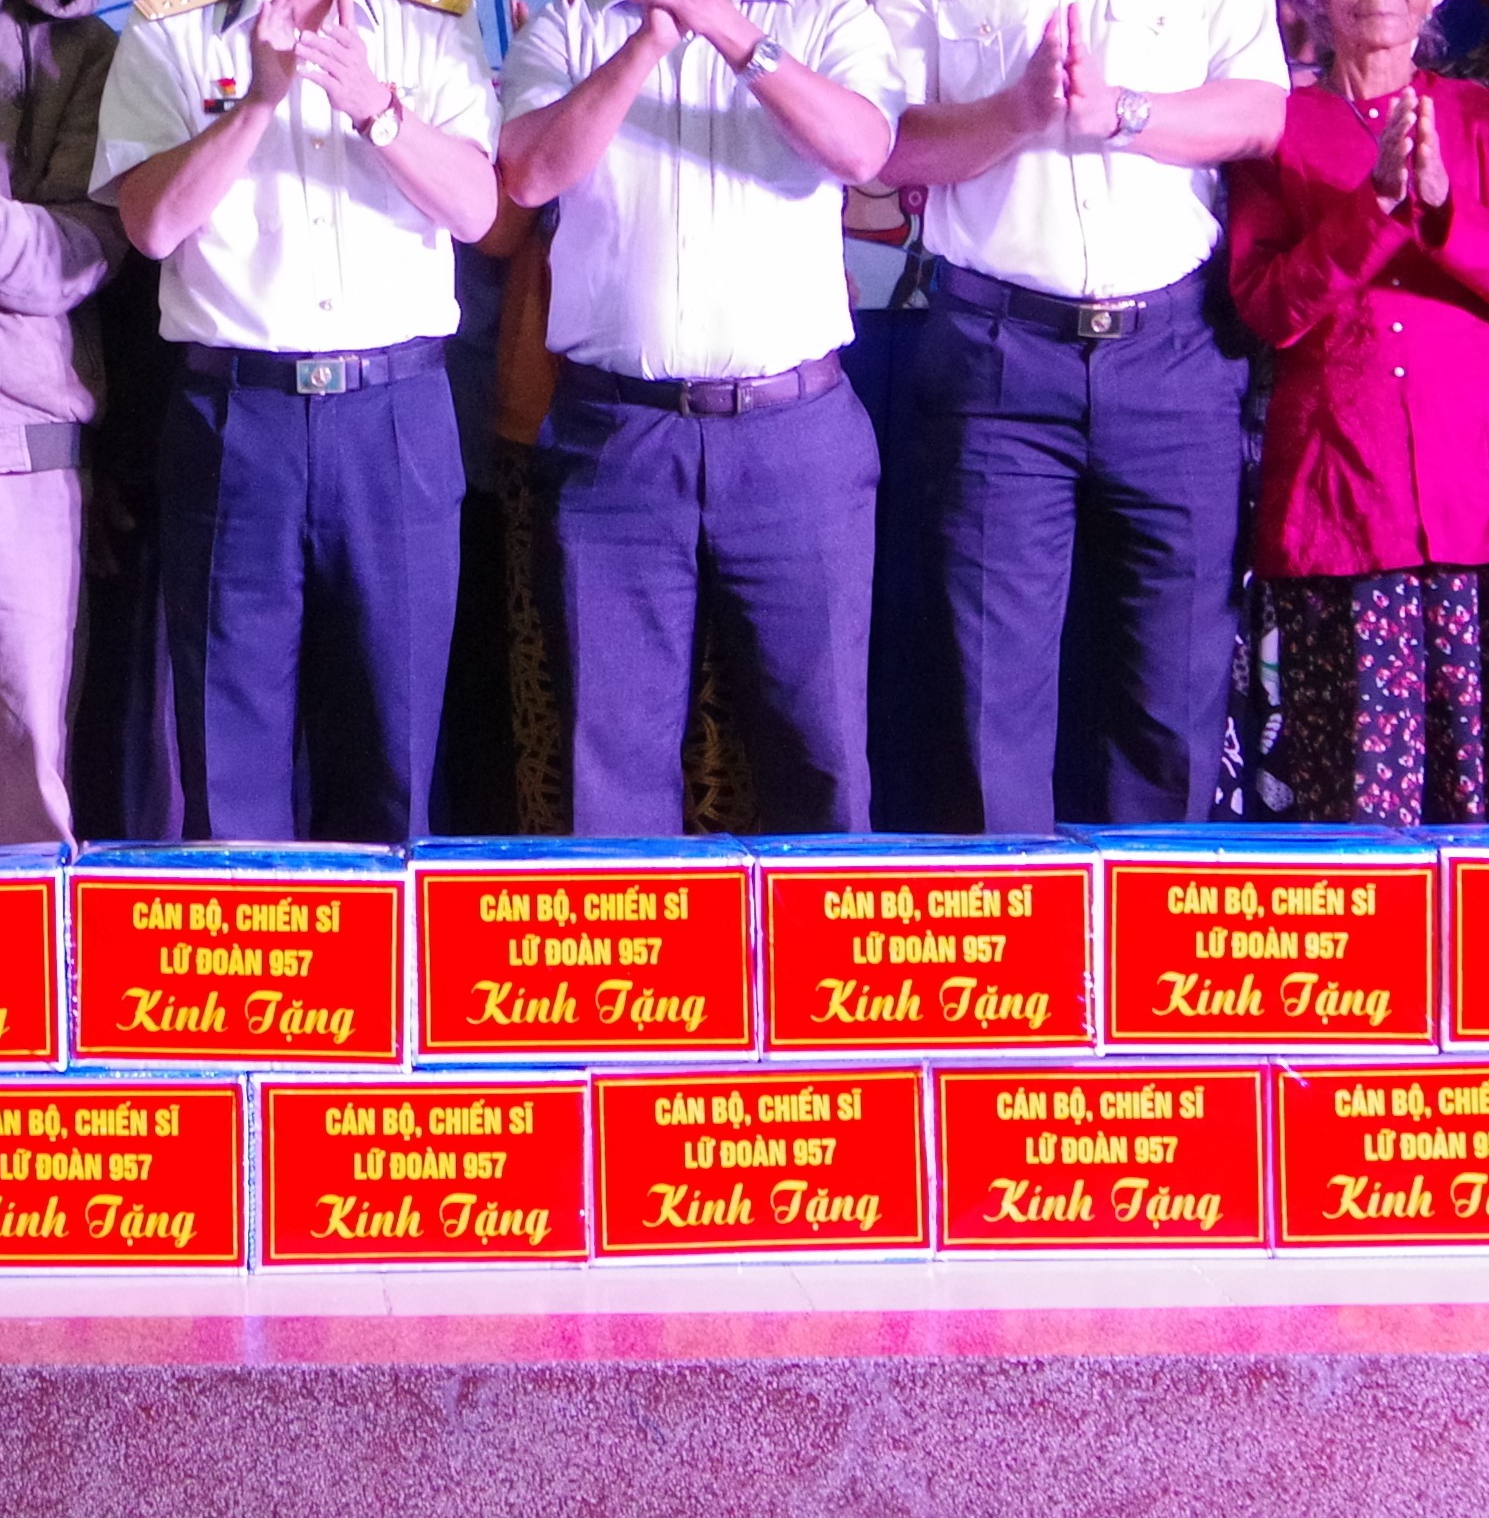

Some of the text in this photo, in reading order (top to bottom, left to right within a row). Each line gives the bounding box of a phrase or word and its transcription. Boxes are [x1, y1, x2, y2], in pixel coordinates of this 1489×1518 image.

[480, 885, 688, 926] CÁN BỘ, CHIẾN SĨ
[1168, 881, 1376, 920] CÁN BỘ, CHIẾN SĨ
[509, 933, 662, 966] LỮ ĐOÀN 957
[1196, 927, 1348, 959] LỮ ĐOÀN 957
[464, 979, 707, 1032] Kính Tặng
[1150, 972, 1393, 1026] Kính Tặng
[29, 1104, 67, 1141] BỘ,
[75, 1102, 147, 1136] CHIẾN
[155, 1105, 179, 1136] SĨ
[655, 1087, 861, 1129] CÁN BỘ, CHIẾN SĨ
[1335, 1085, 1385, 1117] CÁN
[1392, 1083, 1431, 1121] BỘ,
[685, 1135, 836, 1168] LỮ ĐOÀN 957
[1364, 1129, 1396, 1161] LỮ
[1400, 1127, 1466, 1160] ĐOÀN
[0, 1148, 152, 1181] LỮ ĐOÀN 957
[640, 1180, 883, 1231] Kính Tặng
[1320, 1175, 1435, 1219] Kính
[86, 1195, 197, 1248] Tặng
